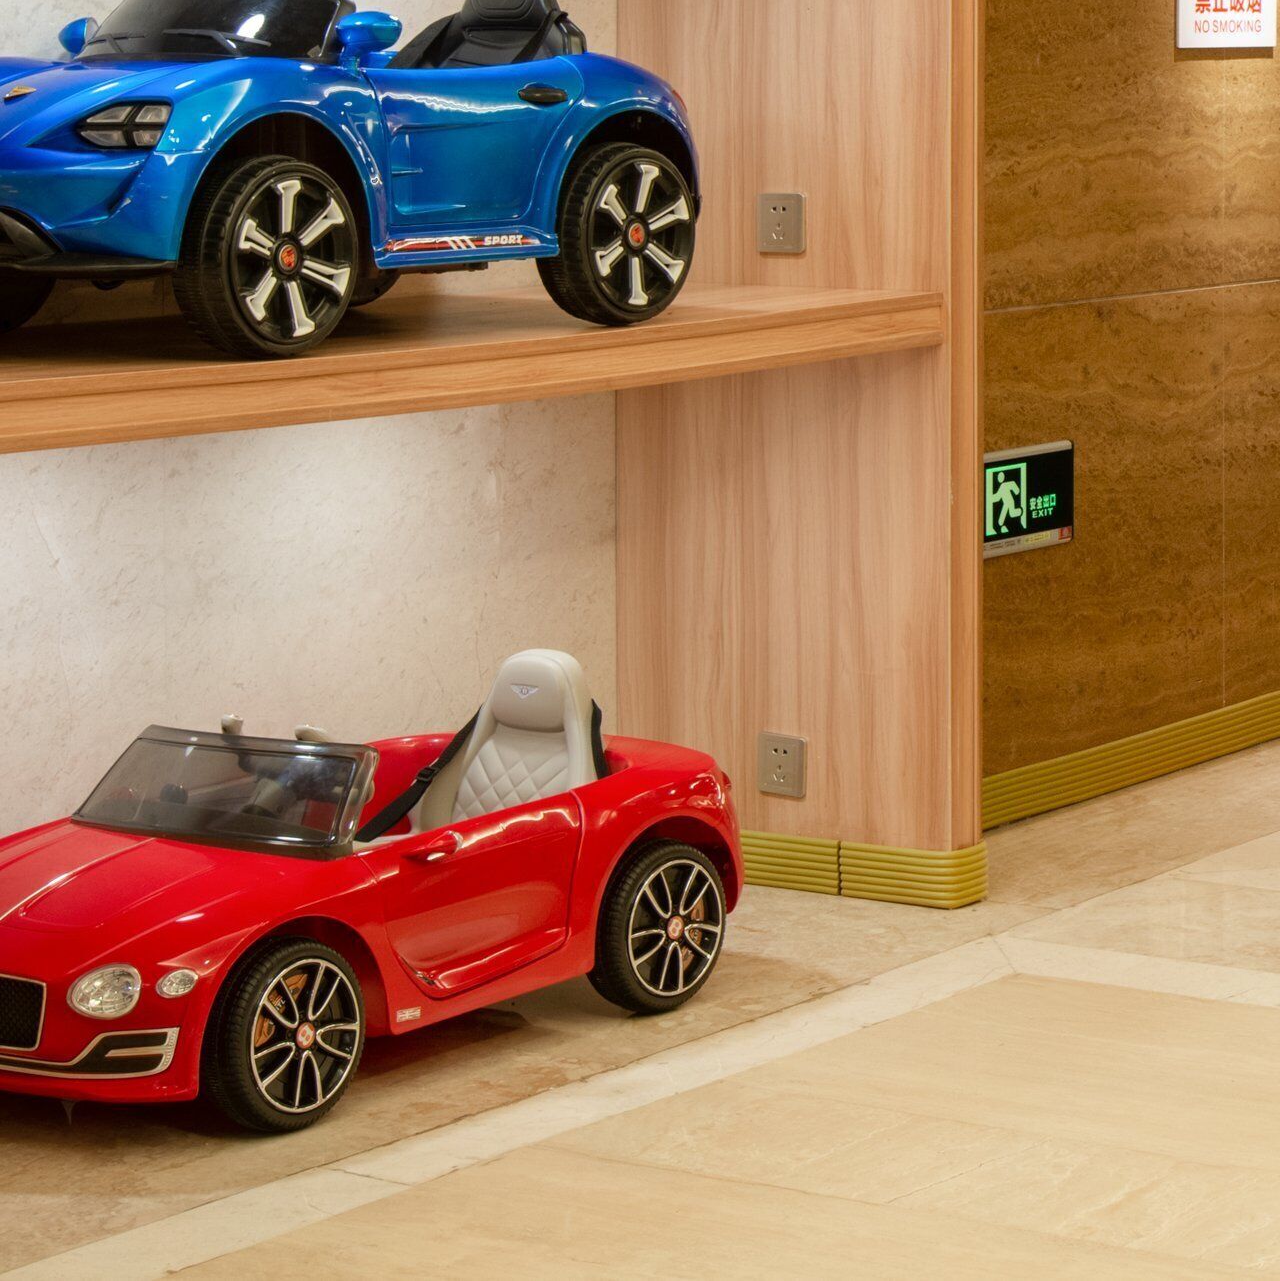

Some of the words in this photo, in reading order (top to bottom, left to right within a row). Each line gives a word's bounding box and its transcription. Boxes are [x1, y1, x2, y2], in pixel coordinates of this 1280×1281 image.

[1194, 19, 1210, 34] NO
[1212, 19, 1262, 34] SMOKING
[483, 234, 523, 246] SPORT
[1032, 507, 1054, 518] EXIT
